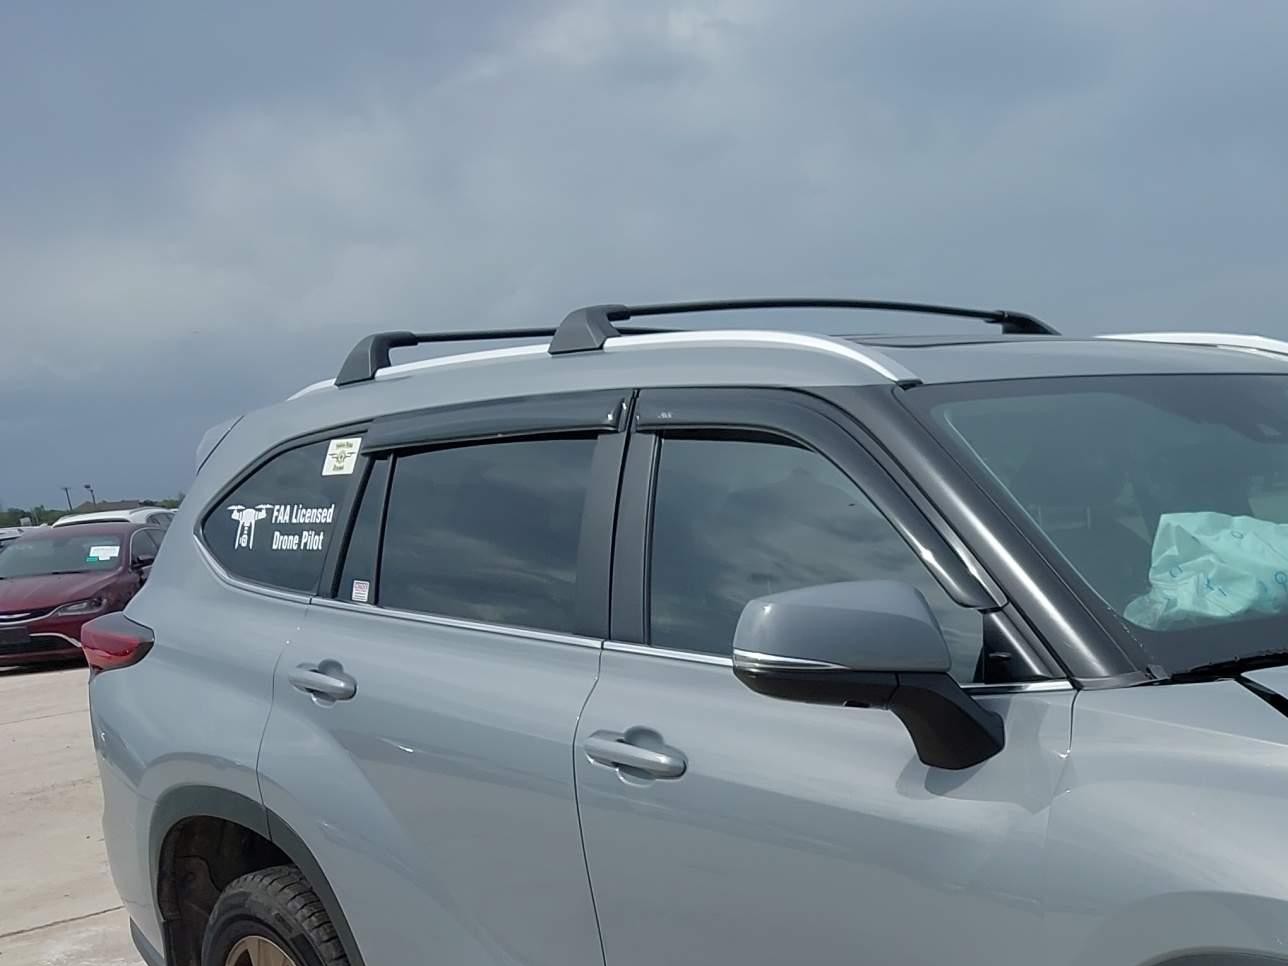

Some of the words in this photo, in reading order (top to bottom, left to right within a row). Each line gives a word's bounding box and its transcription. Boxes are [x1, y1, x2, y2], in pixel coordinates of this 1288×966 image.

[271, 504, 291, 524] FAA
[292, 503, 335, 524] Licensed
[271, 531, 298, 550] Drone
[300, 530, 324, 550] Pilot
